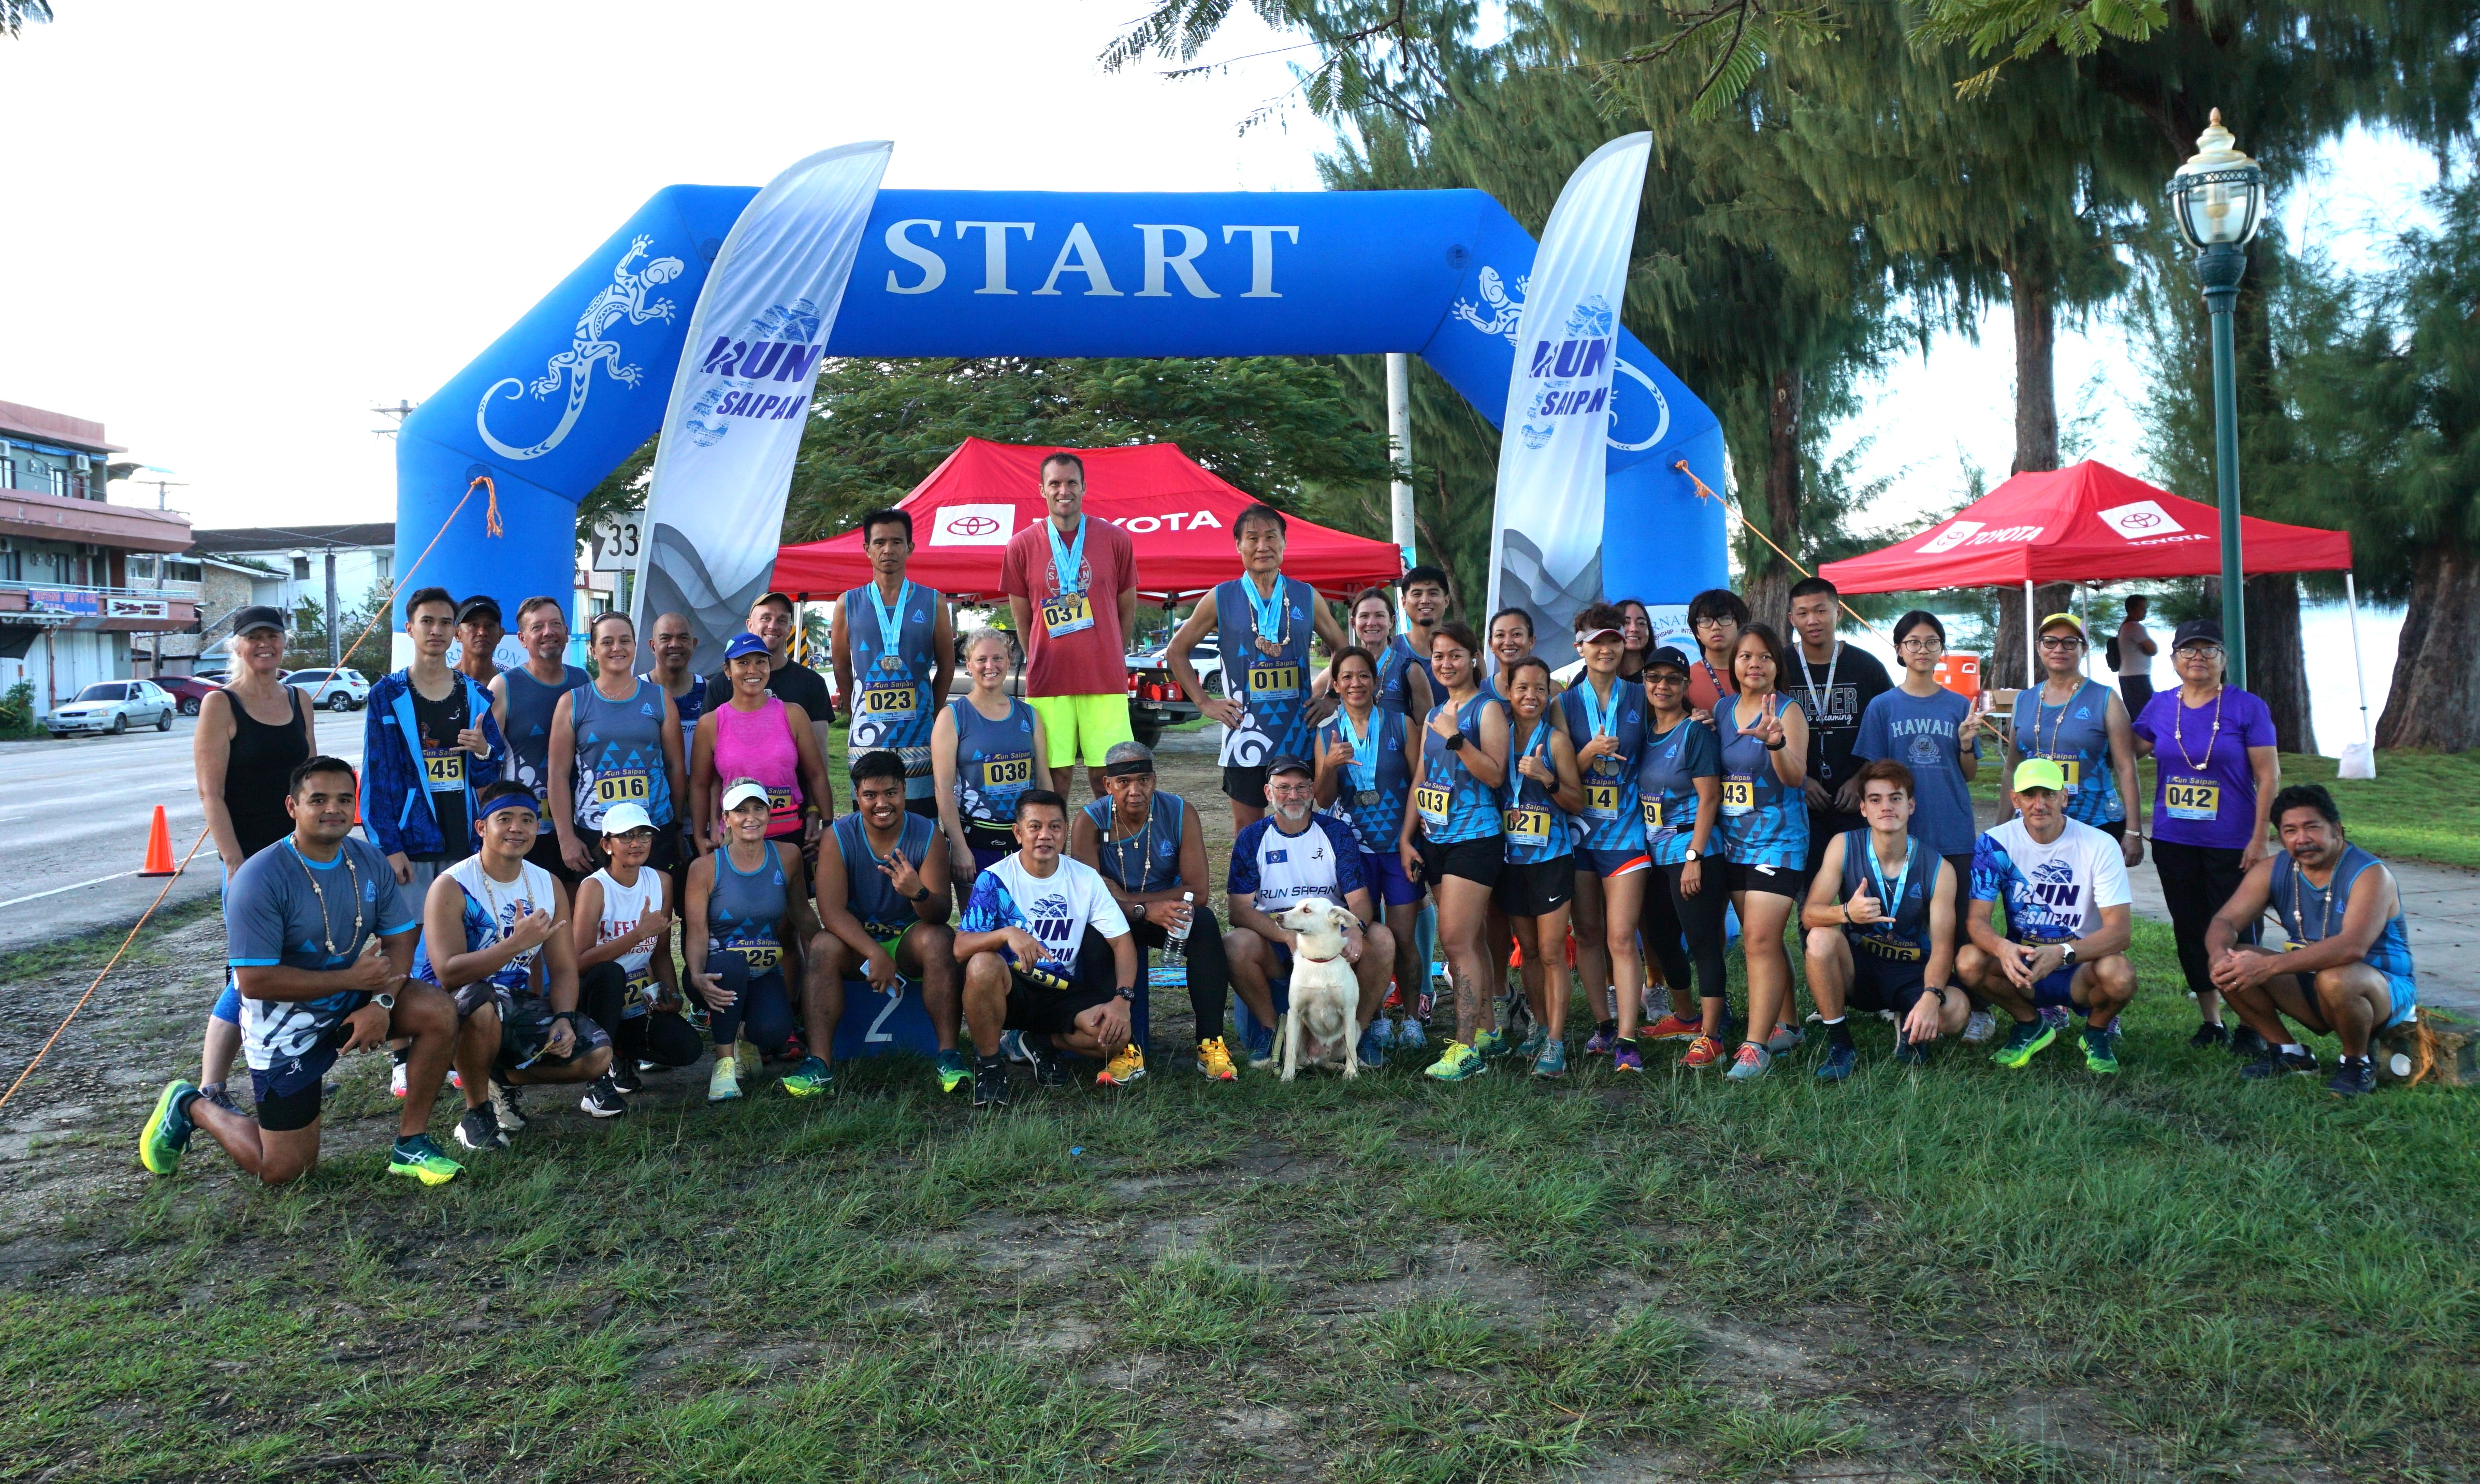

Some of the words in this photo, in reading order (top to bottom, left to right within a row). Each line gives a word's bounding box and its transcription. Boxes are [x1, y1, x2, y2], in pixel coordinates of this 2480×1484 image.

[884, 219, 1299, 298] START
[700, 336, 822, 382] RUN
[1529, 337, 1612, 377] RUN
[716, 391, 806, 420] SAIPAN
[608, 523, 639, 557] 33
[1965, 526, 2044, 546] TOYOTA
[2127, 534, 2211, 546] TOYOTA
[1255, 670, 1292, 689] 011
[870, 691, 911, 711] 023
[1891, 719, 1954, 738] HAWAII
[991, 761, 1027, 783] 038
[2189, 777, 2217, 785] Saipan
[601, 778, 644, 799] 016
[1432, 782, 1450, 791] Saipan
[1418, 790, 1443, 812] 013
[1586, 788, 1611, 807] 14
[2170, 787, 2212, 808] 042
[1507, 813, 1541, 833] 021
[1260, 888, 1288, 899] RUN
[2012, 882, 2080, 906] RUN
[2027, 911, 2082, 927] SAIPAN
[2047, 934, 2074, 943] Saipan
[1867, 941, 1913, 961] 006
[864, 988, 904, 1042] 2
